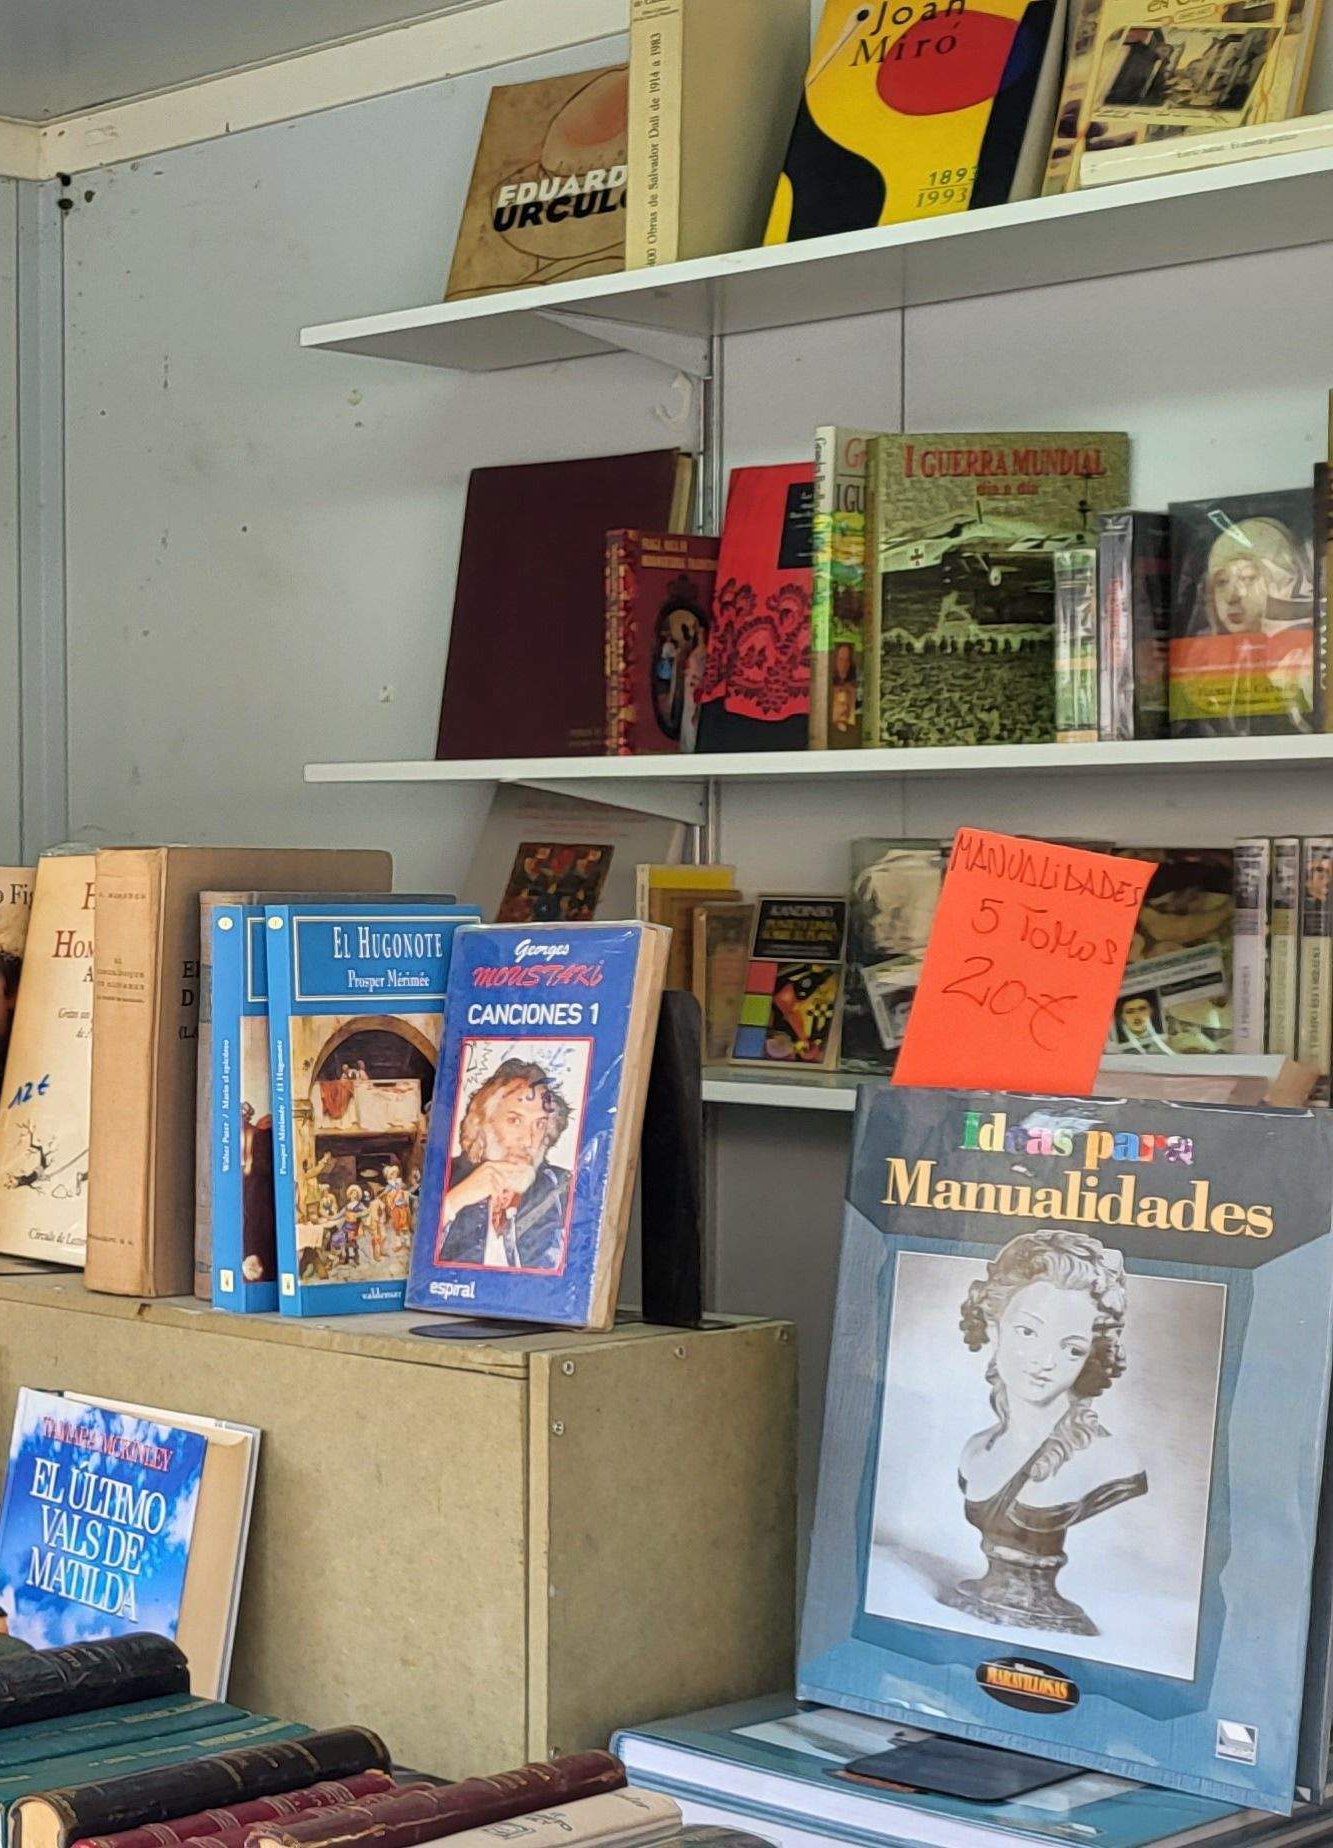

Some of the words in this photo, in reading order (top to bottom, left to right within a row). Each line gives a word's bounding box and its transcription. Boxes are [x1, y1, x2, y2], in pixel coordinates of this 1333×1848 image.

[870, 0, 966, 36] Joan
[650, 32, 661, 56] 1983
[848, 21, 962, 67] Miró
[649, 71, 661, 93] 1914
[649, 98, 661, 111] de
[648, 143, 659, 190] Salvador
[497, 165, 627, 208] EDUARD
[648, 193, 658, 208] de
[916, 187, 969, 208] 1993
[647, 211, 658, 244] Obras
[905, 444, 915, 478] I
[920, 450, 1008, 477] GUERRA
[1012, 449, 1108, 477] MUNDIAL
[971, 898, 1004, 934] 5
[357, 926, 443, 959] HUGONOTE
[514, 938, 570, 963] Georges
[347, 969, 385, 992] Prosper
[386, 968, 430, 988] Mérimée
[468, 1003, 583, 1025] CANCIONES
[589, 1003, 600, 1025] 1
[958, 1111, 1075, 1157] Ideas
[1082, 1129, 1196, 1170] para
[882, 1157, 1275, 1239] Manualidades
[430, 1280, 476, 1301] espiral
[30, 1457, 65, 1504] EL
[68, 1461, 166, 1534] ÚLTIMO
[41, 1505, 103, 1562] VALS
[103, 1525, 145, 1576] DE
[26, 1547, 138, 1623] MATILDA
[986, 1666, 1069, 1700] MARAVILLOSAS
